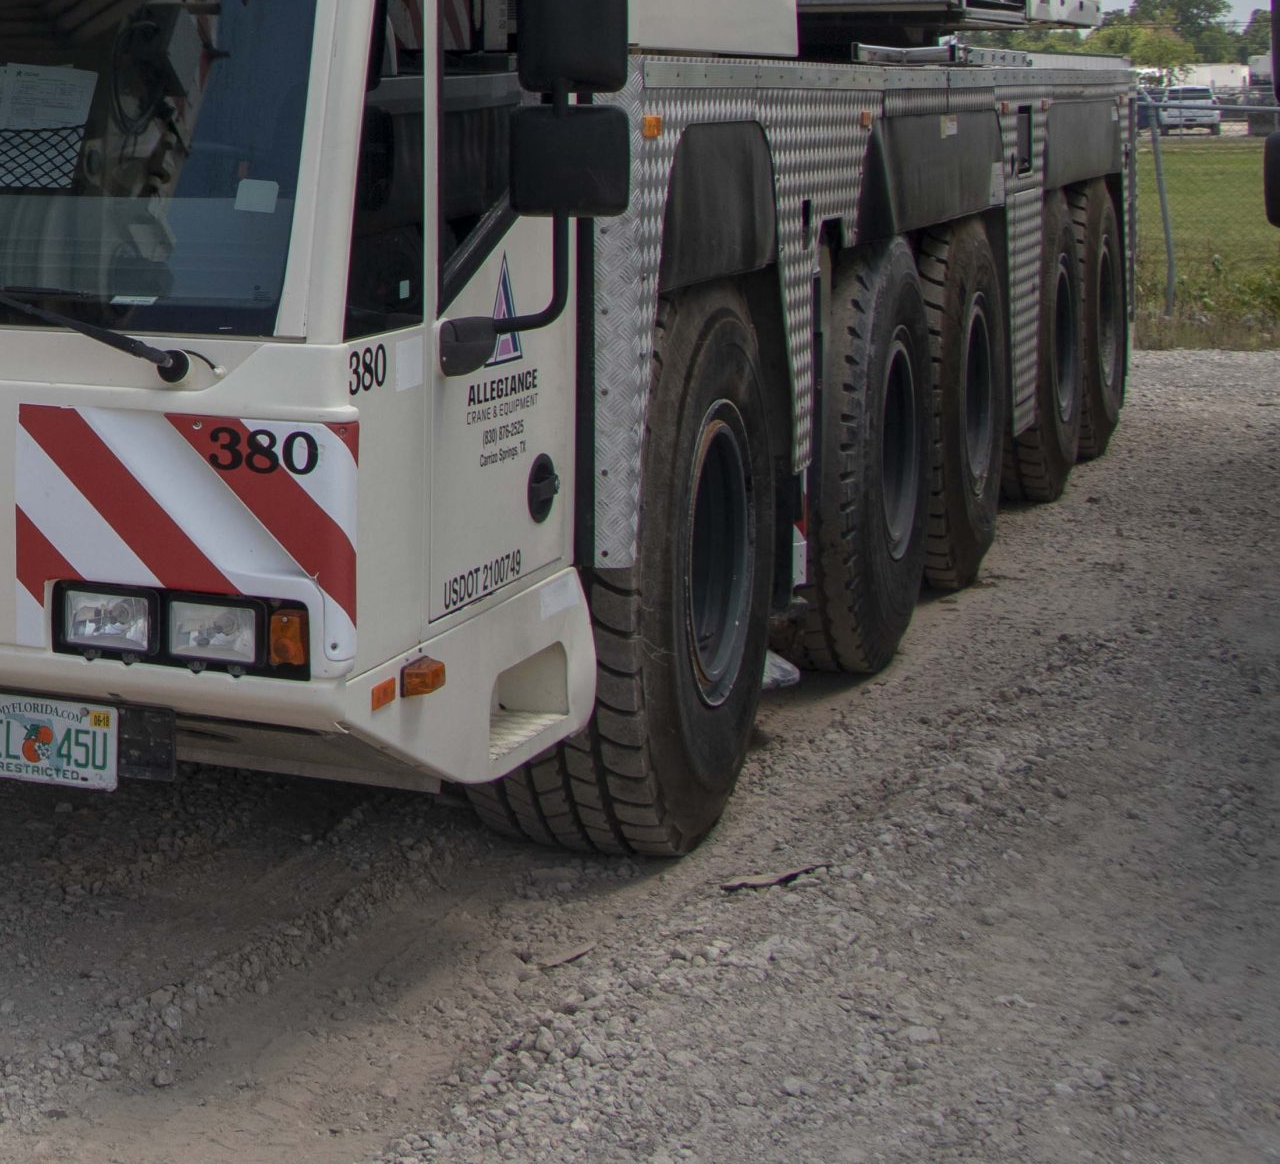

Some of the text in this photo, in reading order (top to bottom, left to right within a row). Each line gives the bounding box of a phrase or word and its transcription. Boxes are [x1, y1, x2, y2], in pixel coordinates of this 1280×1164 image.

[349, 343, 387, 396] 380
[467, 369, 538, 407] ALLEGIANCE
[466, 407, 491, 426] CRANE
[499, 393, 539, 417] EQUIPMENT
[209, 427, 319, 475] 380
[482, 428, 498, 449] (830)
[519, 439, 527, 453] TX
[443, 549, 521, 610] USDOT 2100749
[56, 728, 108, 771] 45U
